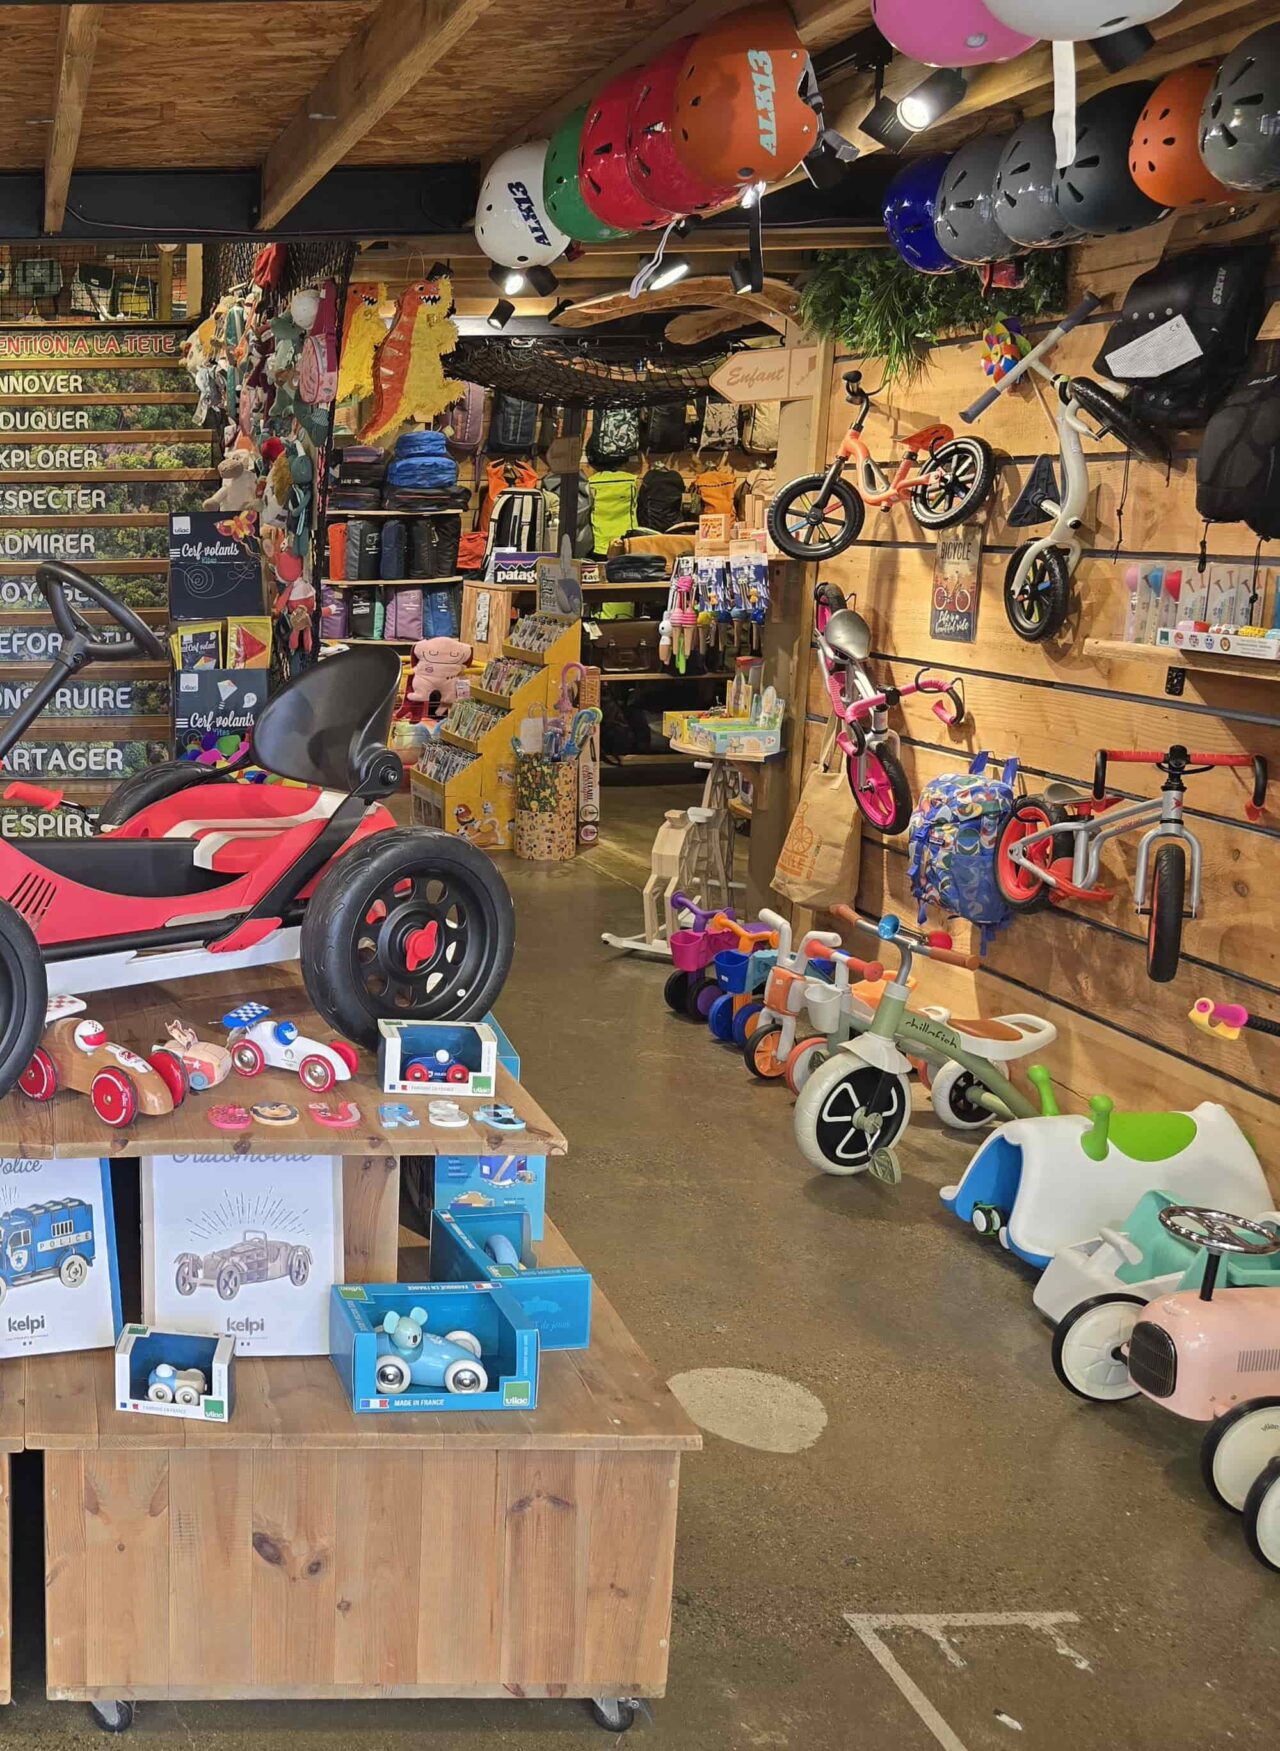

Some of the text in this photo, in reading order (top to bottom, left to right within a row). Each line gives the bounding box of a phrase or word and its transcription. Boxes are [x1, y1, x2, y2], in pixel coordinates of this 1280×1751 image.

[747, 49, 777, 156] ALK13
[507, 180, 552, 247] ALK13
[73, 335, 90, 354] A
[94, 335, 122, 354] LA
[124, 334, 176, 354] TETE
[726, 366, 785, 388] Enfant
[940, 541, 971, 561] BICYCLE
[0, 749, 123, 771] RTAGER
[905, 1017, 957, 1049] chillafish
[39, 1232, 91, 1250] POLICE
[7, 1315, 46, 1334] kelpi
[226, 1317, 265, 1335] kelpi
[394, 1399, 413, 1407] MADE
